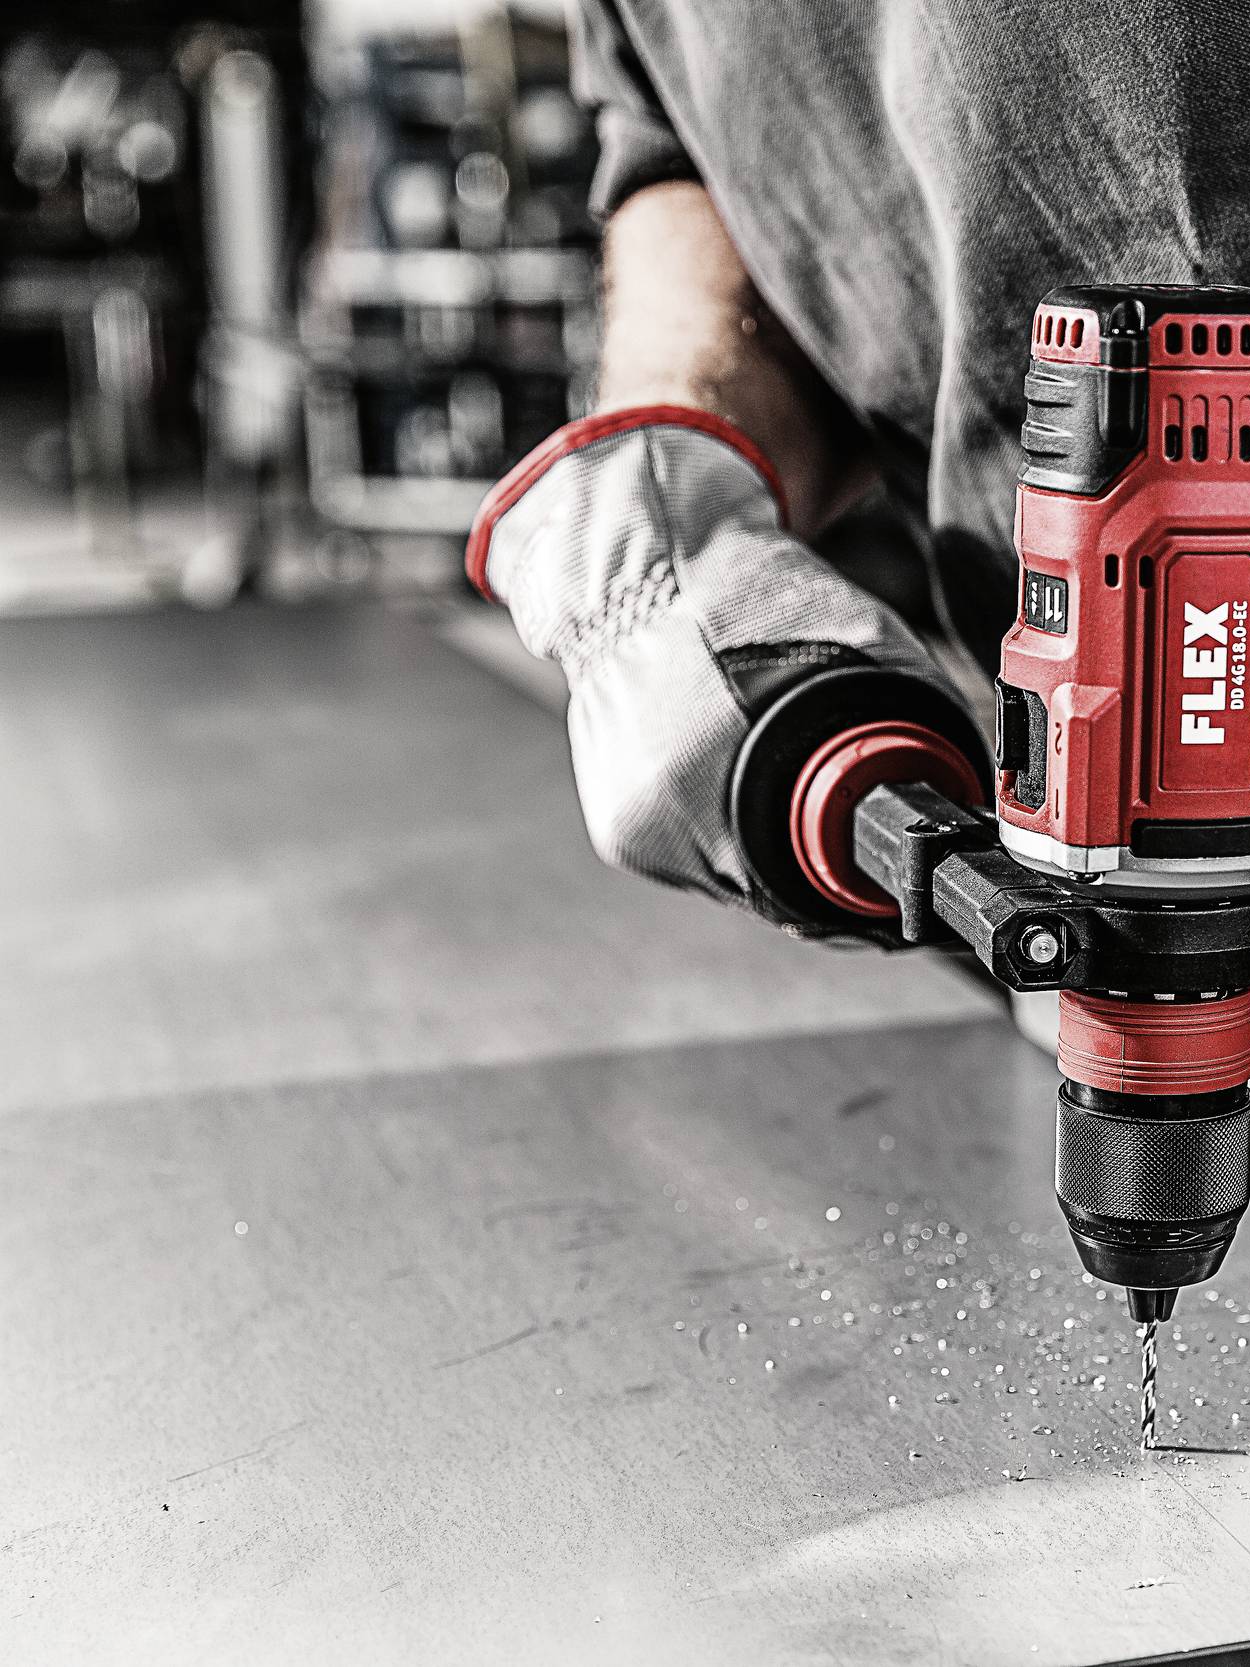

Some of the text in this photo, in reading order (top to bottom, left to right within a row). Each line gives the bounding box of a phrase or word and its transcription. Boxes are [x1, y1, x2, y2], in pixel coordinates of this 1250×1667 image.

[1180, 601, 1229, 744] FLEX
[1230, 600, 1248, 710] DD 4G 18.0-EC
